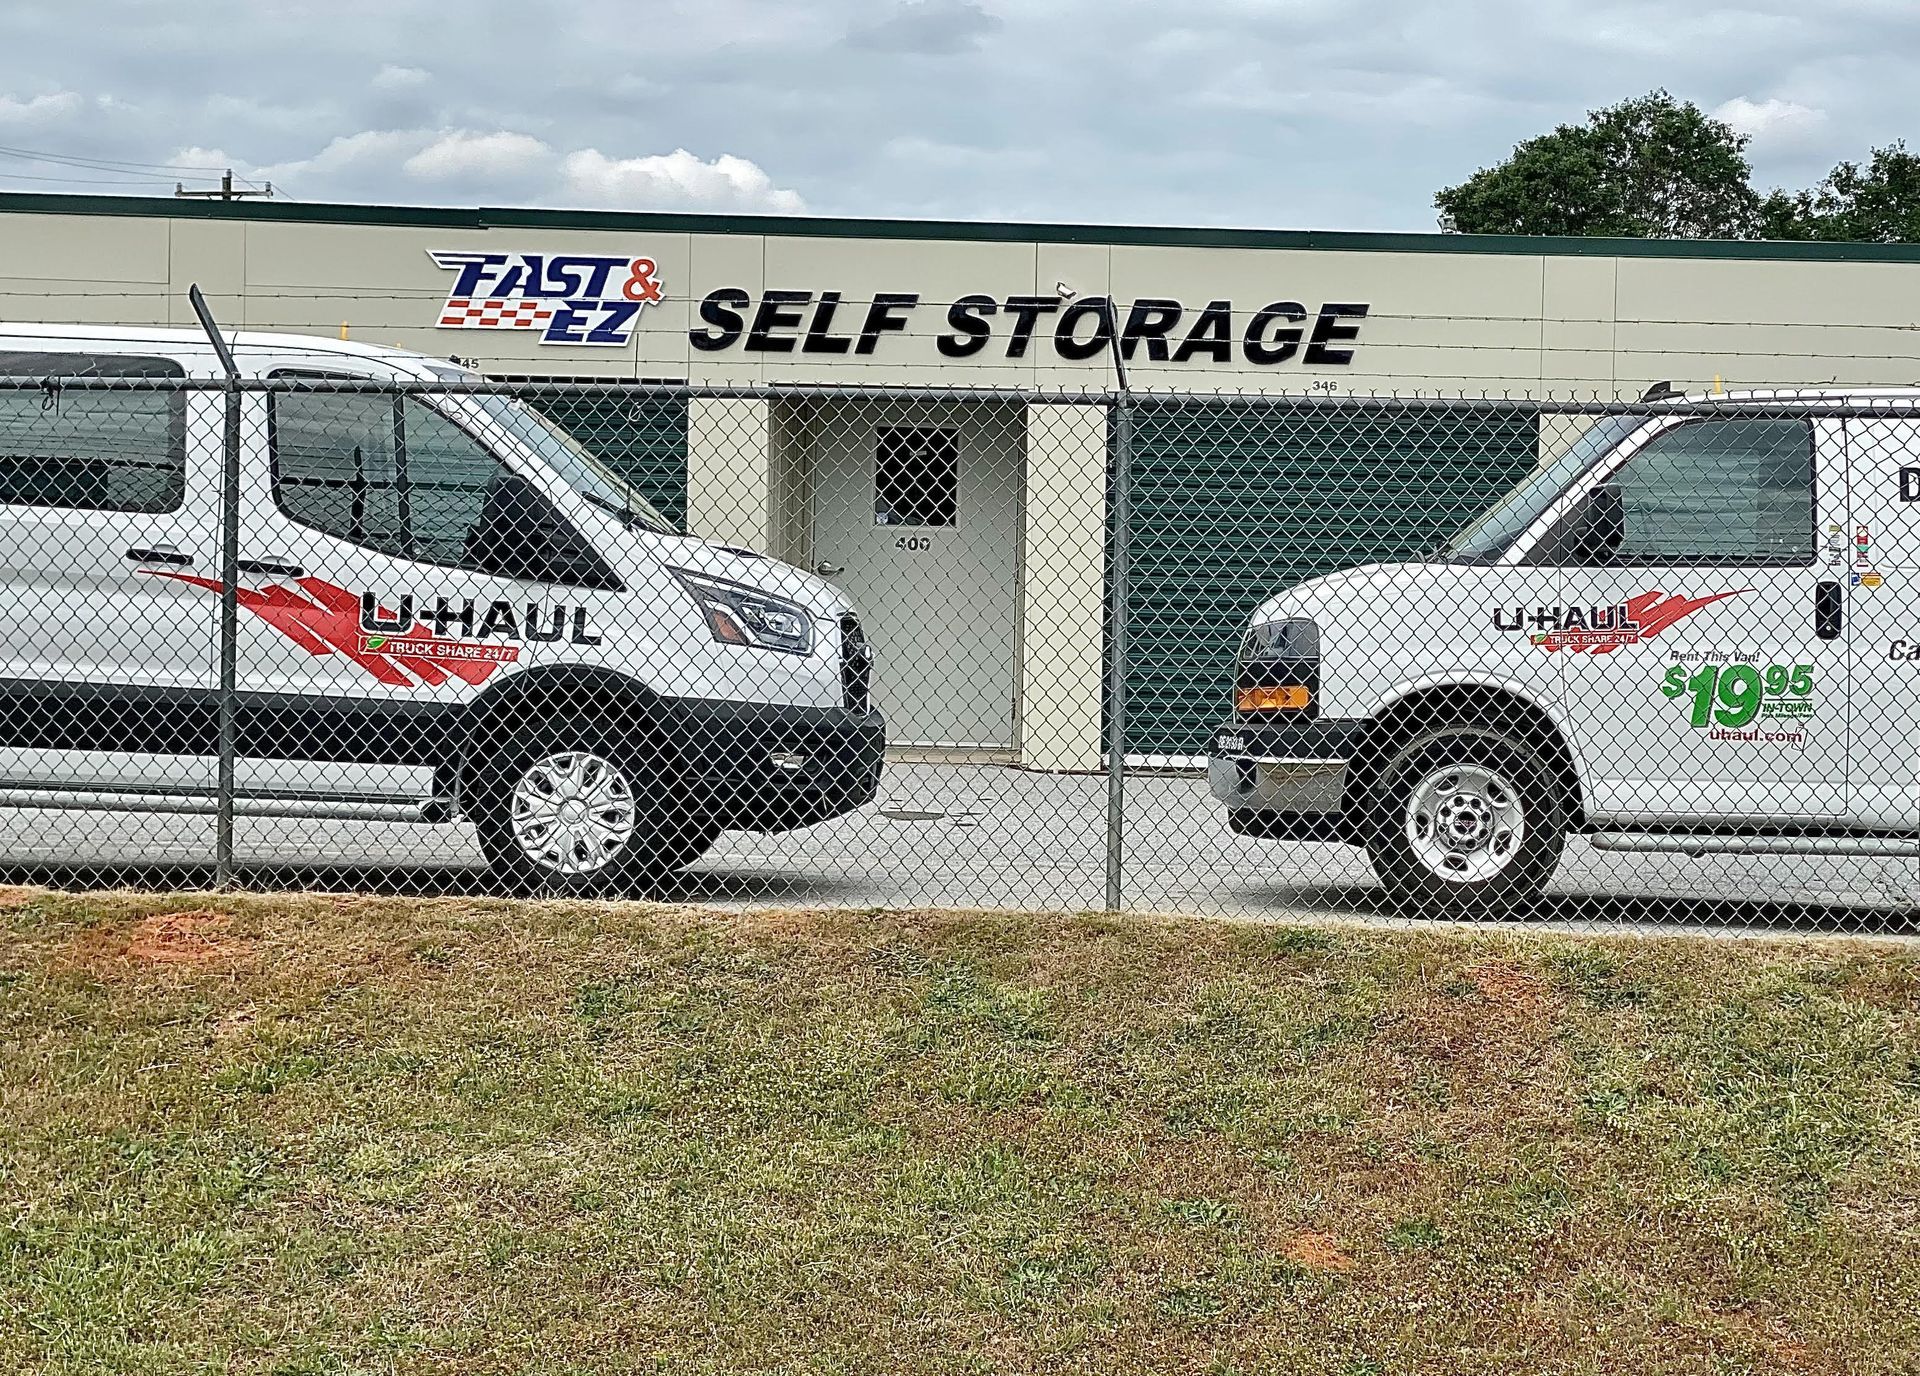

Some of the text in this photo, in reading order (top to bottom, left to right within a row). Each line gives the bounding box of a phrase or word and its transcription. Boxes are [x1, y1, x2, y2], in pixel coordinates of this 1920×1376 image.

[431, 252, 630, 298] FAST
[543, 300, 643, 343] EZ
[689, 287, 1371, 365] SELF STORAGE
[1312, 380, 1338, 391] 346
[895, 537, 931, 551] 400
[361, 591, 602, 646] U-HAUL
[1494, 606, 1639, 631] U-HAUL
[1550, 635, 1635, 644] TRUCK SHARE 24/7
[389, 641, 514, 660] TRUCK SHARE 24/7
[1670, 650, 1761, 662] Rent This Van!
[1709, 728, 1803, 742] uhaul.com
